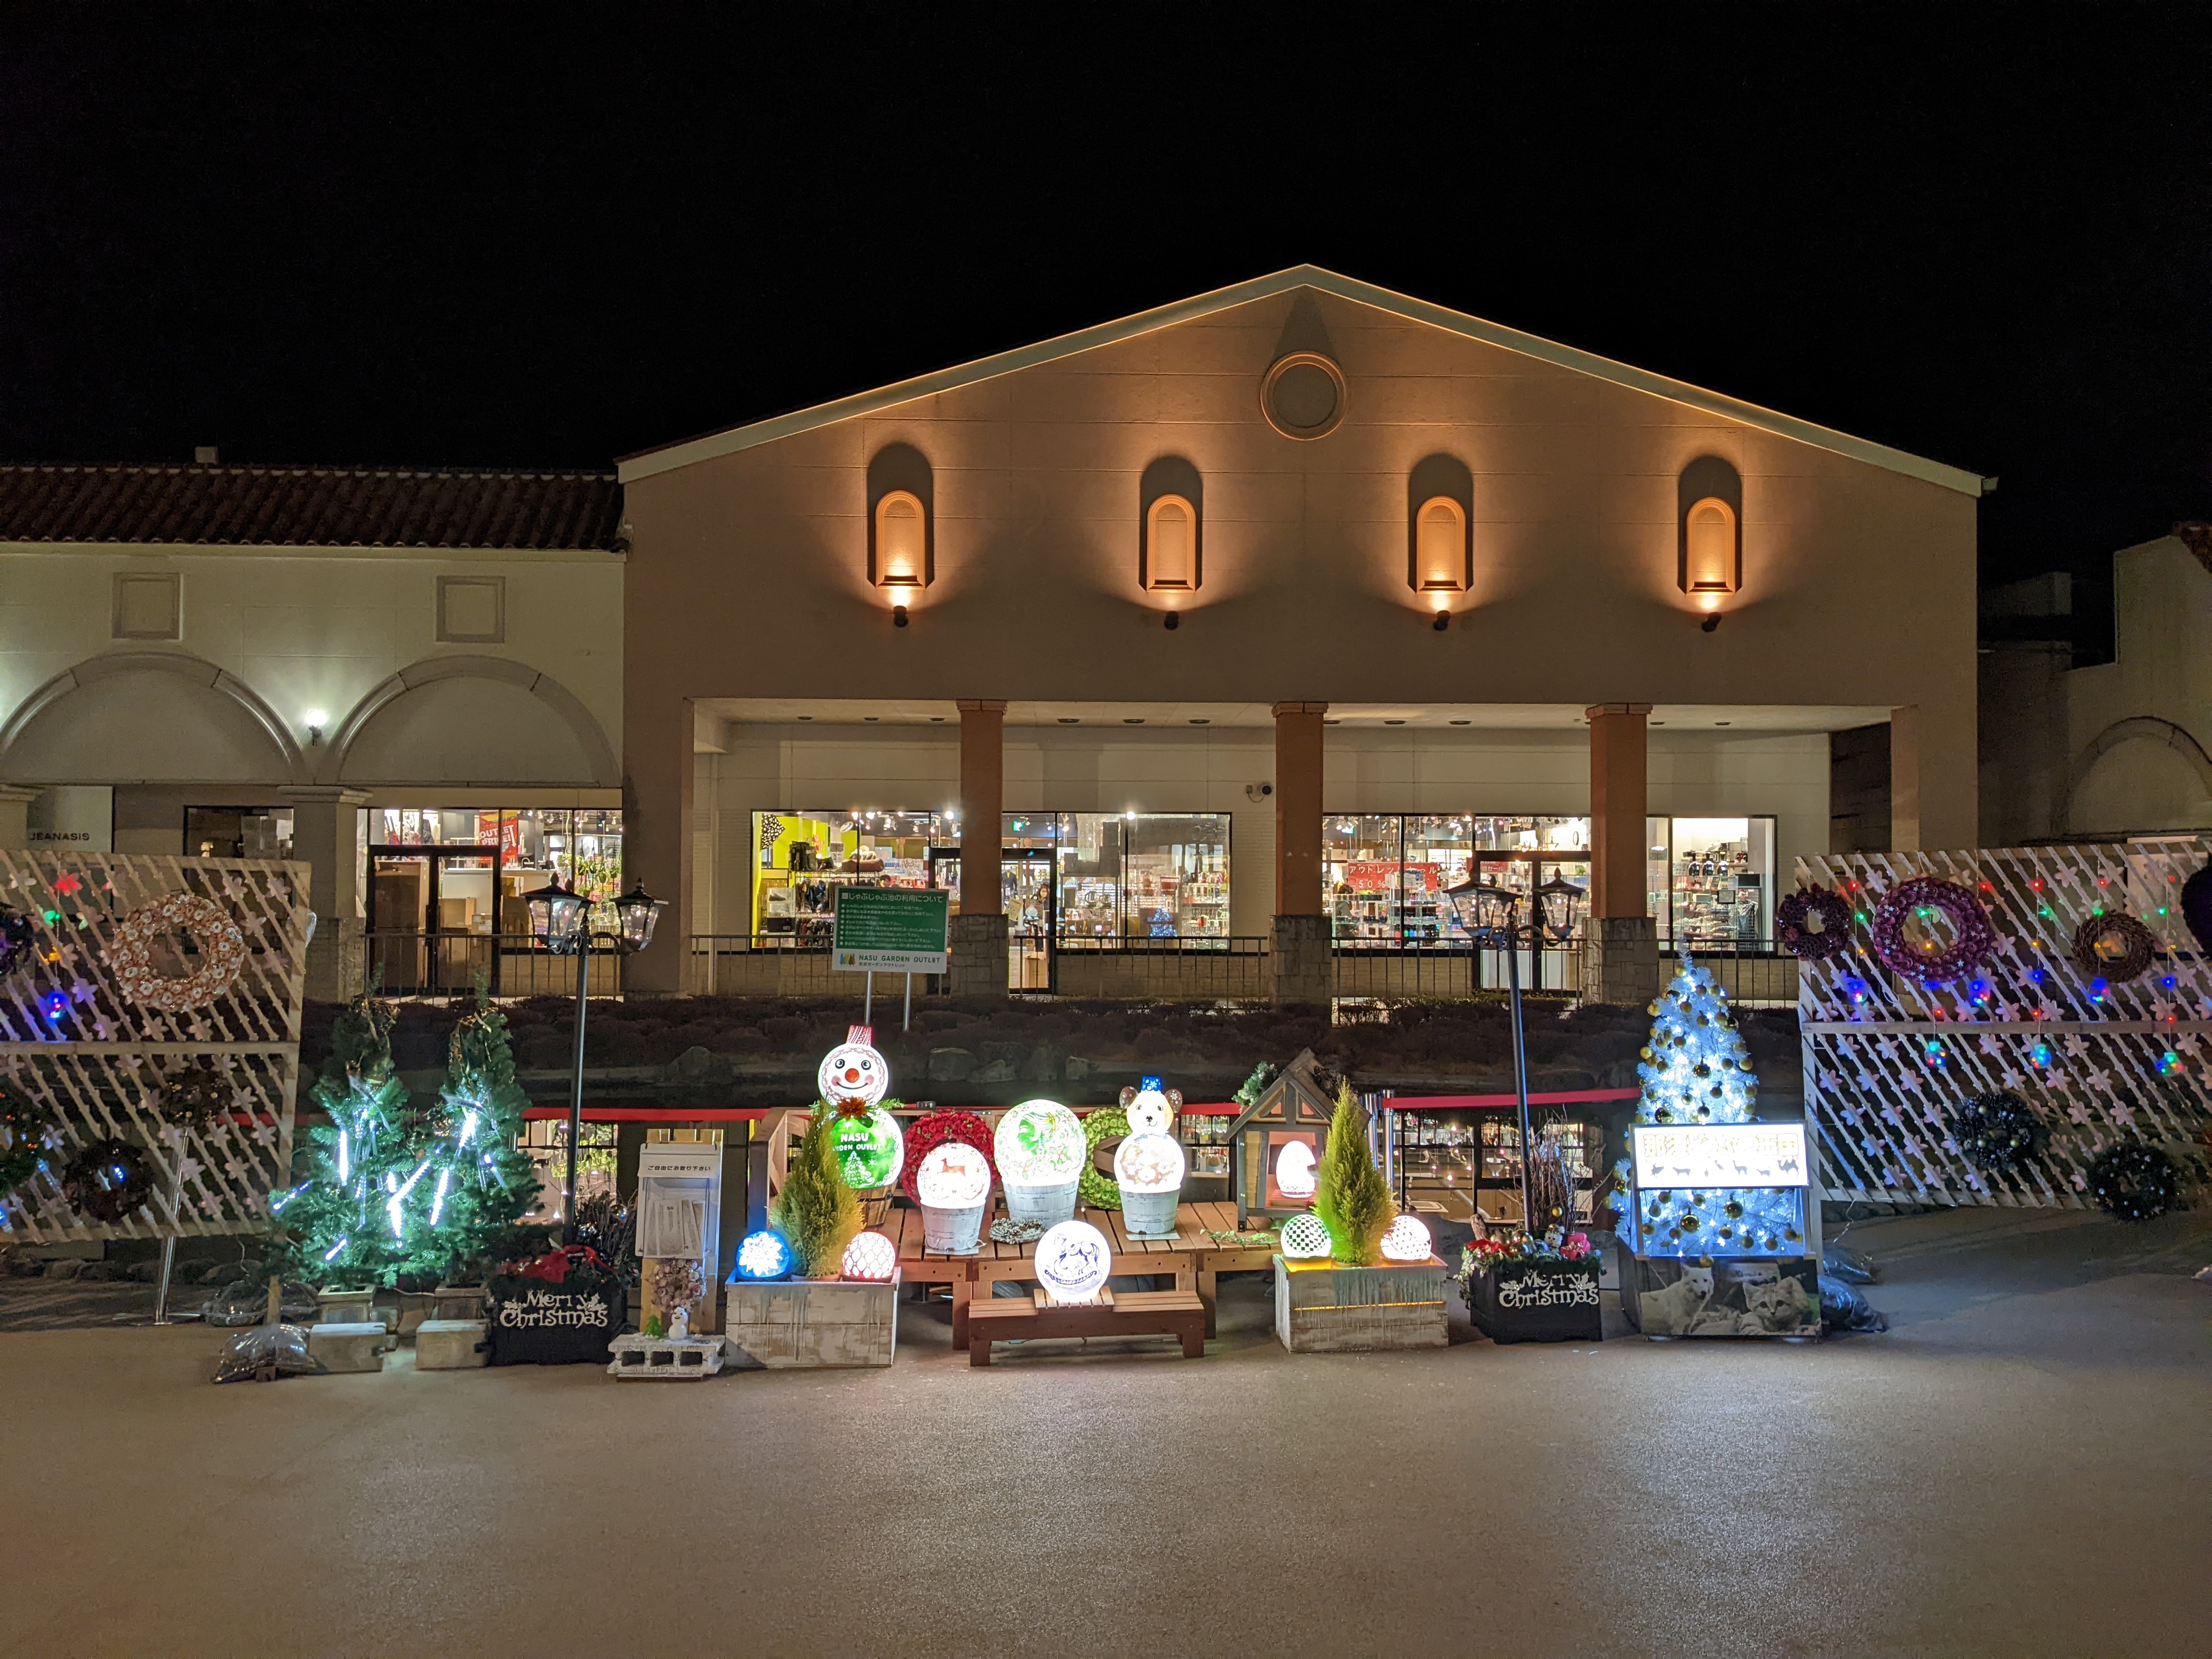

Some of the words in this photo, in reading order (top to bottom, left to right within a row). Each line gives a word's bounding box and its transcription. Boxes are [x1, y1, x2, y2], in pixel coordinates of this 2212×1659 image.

[479, 825, 514, 839] OUTET
[481, 834, 511, 845] PRIE!
[848, 892, 943, 903] じゃぶじゃぶ池の利用について
[840, 1132, 868, 1142] NASU
[1643, 1133, 1799, 1158] 那須どうぶつ王国
[1520, 1270, 1581, 1289] Merry
[1499, 1288, 1599, 1309] Christmas
[500, 1308, 608, 1329] Christmas
